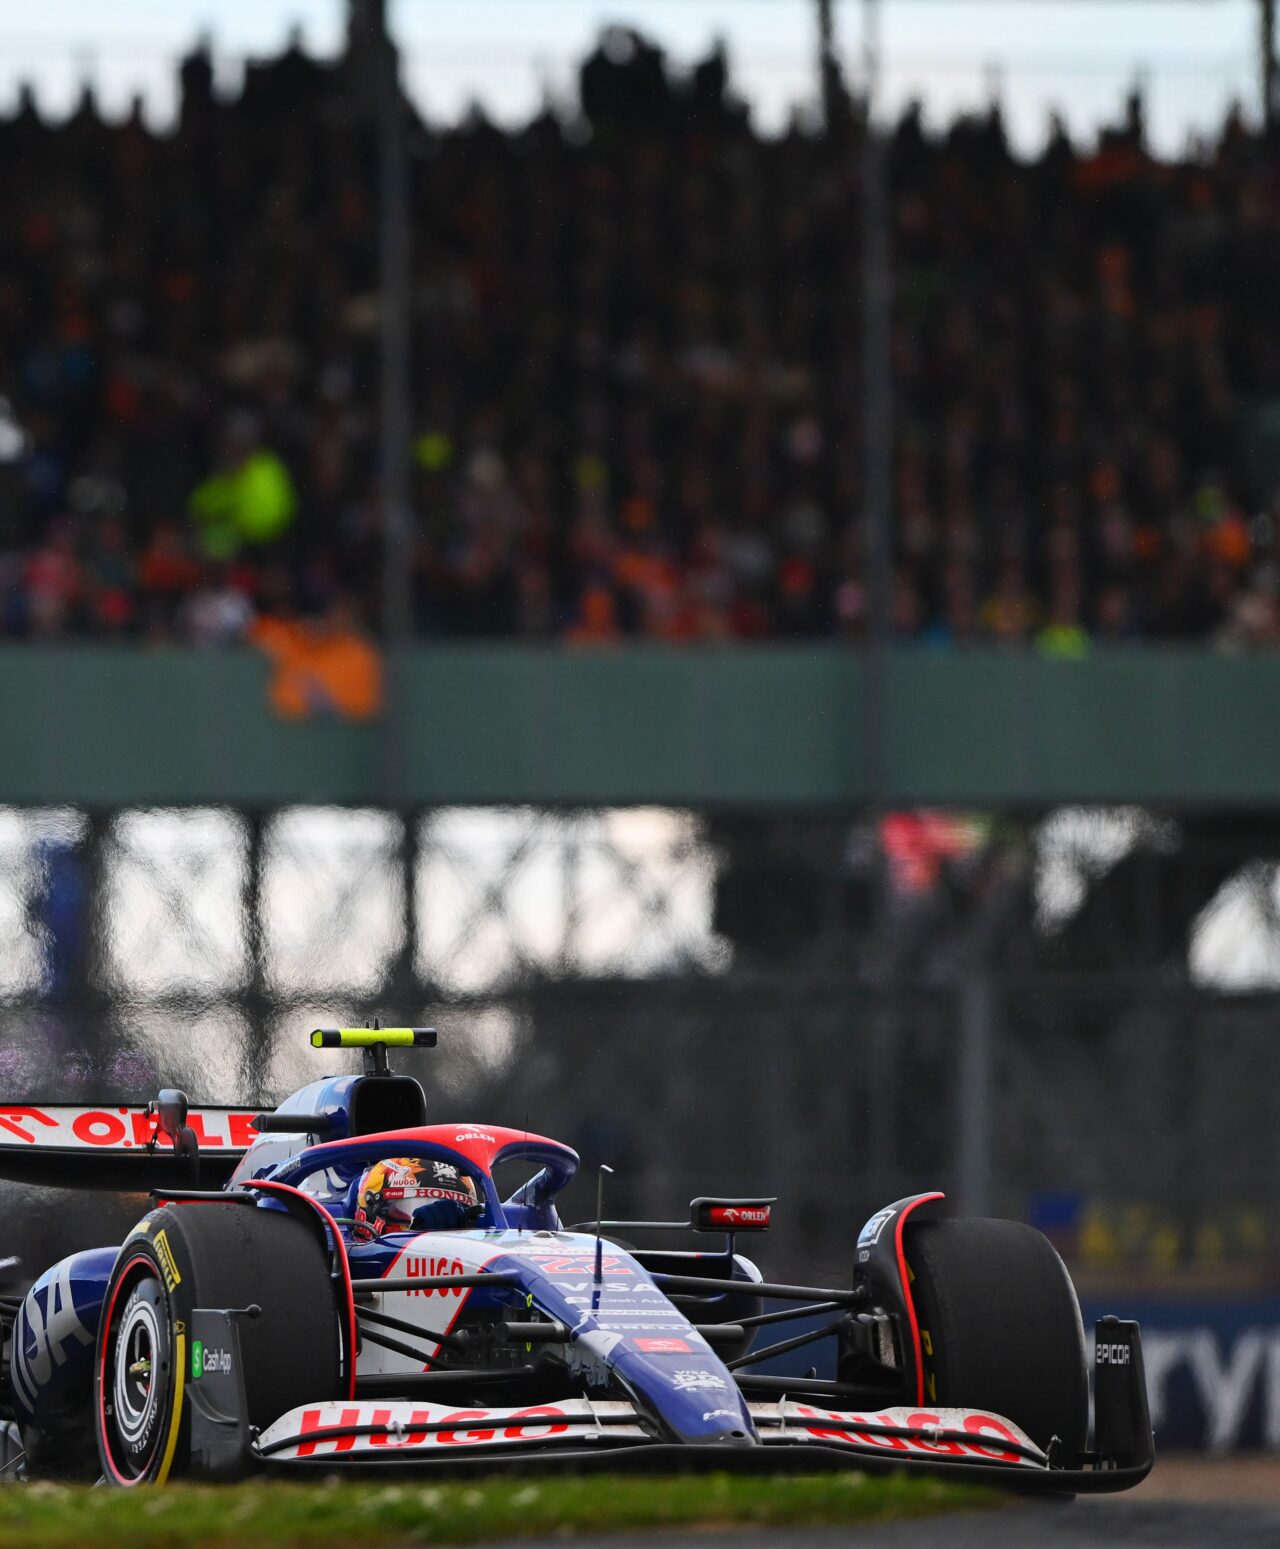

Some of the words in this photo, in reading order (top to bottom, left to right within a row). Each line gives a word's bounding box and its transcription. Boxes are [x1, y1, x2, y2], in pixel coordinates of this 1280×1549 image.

[72, 1111, 266, 1146] ORLE
[455, 1133, 496, 1143] ORLEN
[416, 1188, 473, 1206] HONDA
[741, 1210, 767, 1222] ORLEN
[153, 1229, 181, 1293] PIRELLI
[529, 1255, 634, 1274] 22
[406, 1257, 464, 1297] HUGO
[550, 1282, 662, 1292] VISA
[1096, 1344, 1131, 1365] EPICOR
[296, 1406, 571, 1456] HUGO
[797, 1407, 1020, 1462] HUGO
